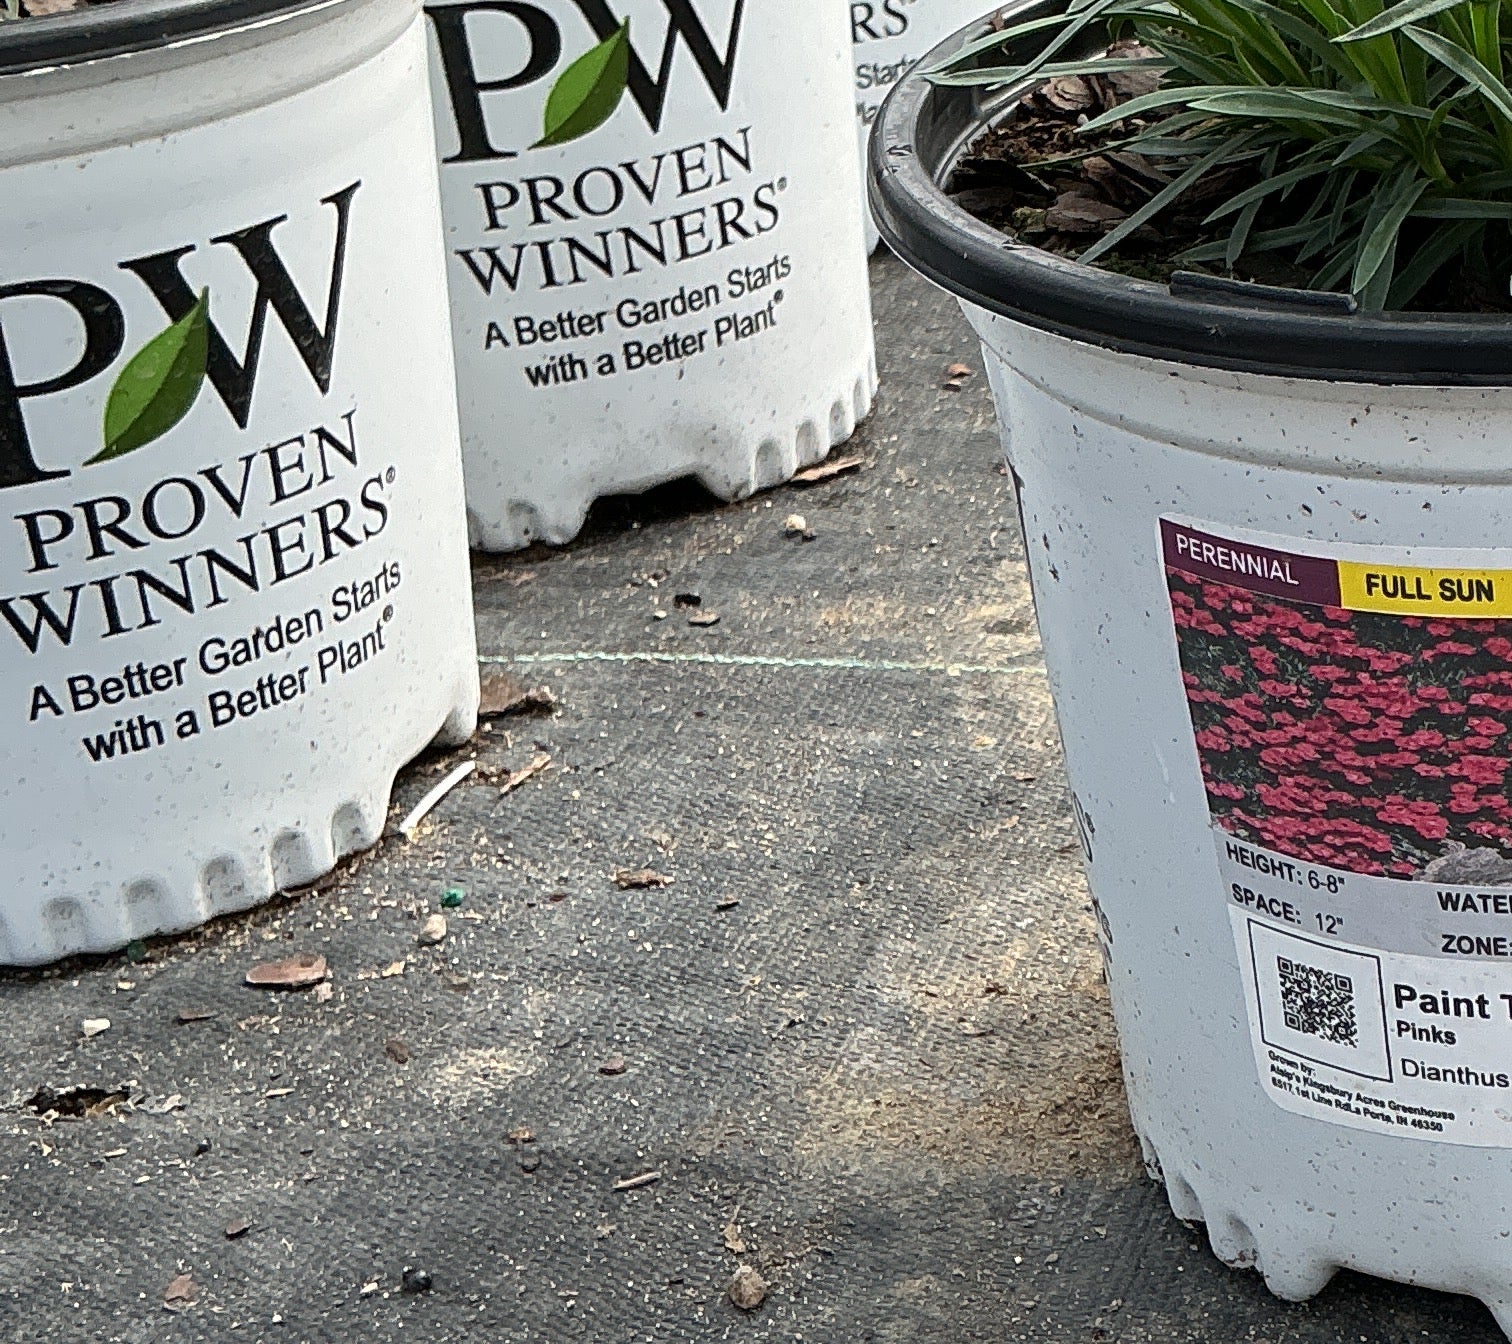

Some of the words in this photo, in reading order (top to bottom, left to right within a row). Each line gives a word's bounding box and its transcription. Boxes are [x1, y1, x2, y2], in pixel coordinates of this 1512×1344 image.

[475, 127, 753, 231] PROVEN
[484, 322, 509, 350] A
[517, 305, 607, 347] Better
[616, 277, 721, 327] Garden
[727, 255, 792, 297] Starts
[525, 355, 588, 389] with
[599, 351, 616, 375] a
[623, 328, 707, 372] Better
[15, 409, 358, 573] PROVEN
[1175, 533, 1299, 586] PERENNIAL
[1366, 573, 1432, 601] FULL
[1439, 578, 1494, 602] SUN
[29, 684, 63, 720] A
[69, 655, 187, 713] Better
[198, 607, 324, 676] Garden
[332, 560, 402, 623] Starts
[83, 715, 164, 761] with
[176, 711, 198, 738] a
[212, 665, 309, 728] Better
[1226, 841, 1302, 886] HEIGHT:
[1308, 869, 1345, 895] 6-8"
[1231, 883, 1301, 924] SPACE:
[1315, 913, 1344, 935] 12"
[1394, 983, 1490, 1020] Paint
[1396, 1020, 1457, 1045] Pinks
[1400, 1058, 1511, 1088] Dianthus
[1355, 1092, 1386, 1109] Acres
[1388, 1099, 1455, 1121] Greenhouse
